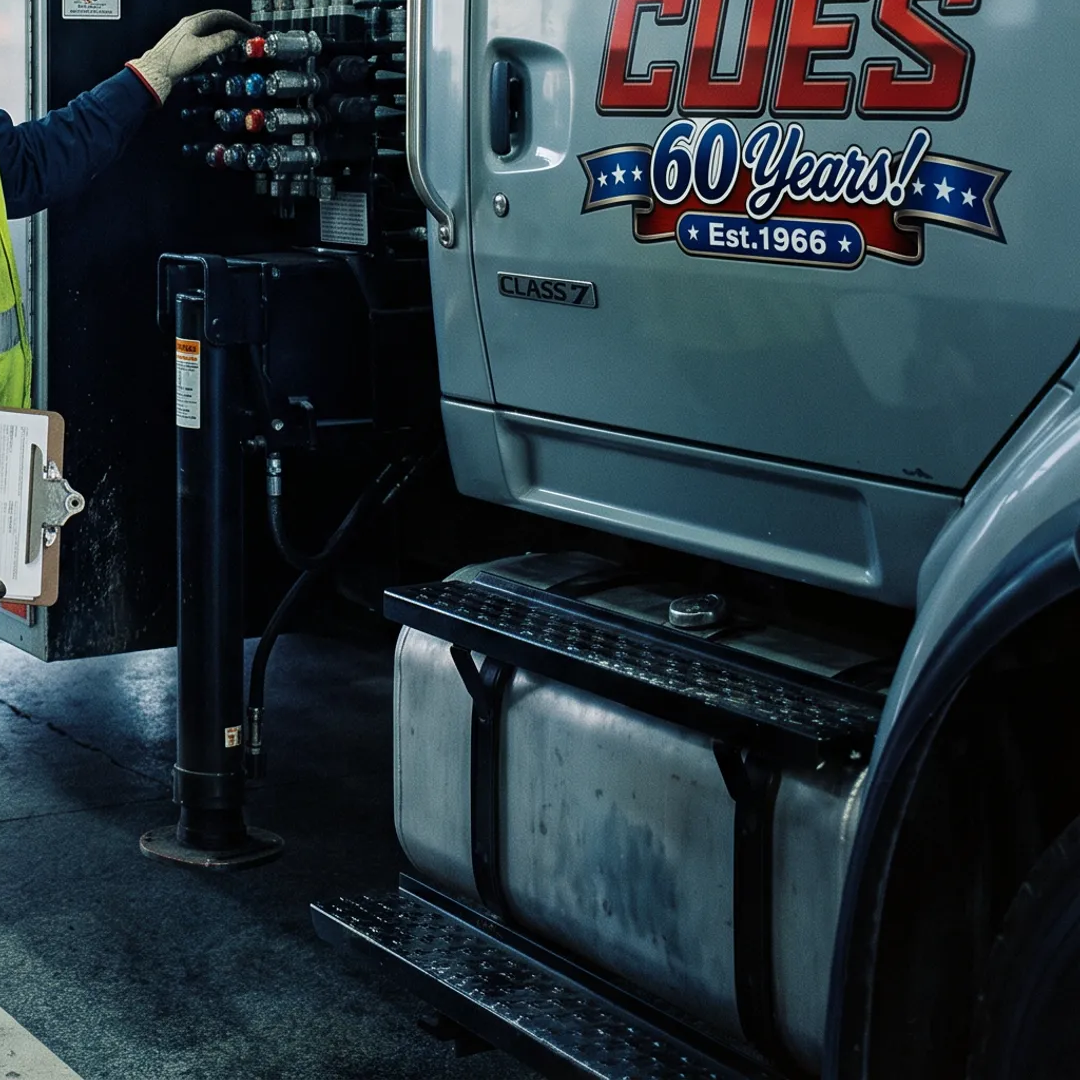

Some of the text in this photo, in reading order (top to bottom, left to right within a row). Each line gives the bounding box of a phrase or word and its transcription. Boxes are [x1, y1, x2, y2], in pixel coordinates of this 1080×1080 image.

[650, 118, 930, 219] 60 Years!
[500, 275, 589, 304] CLASS 7
